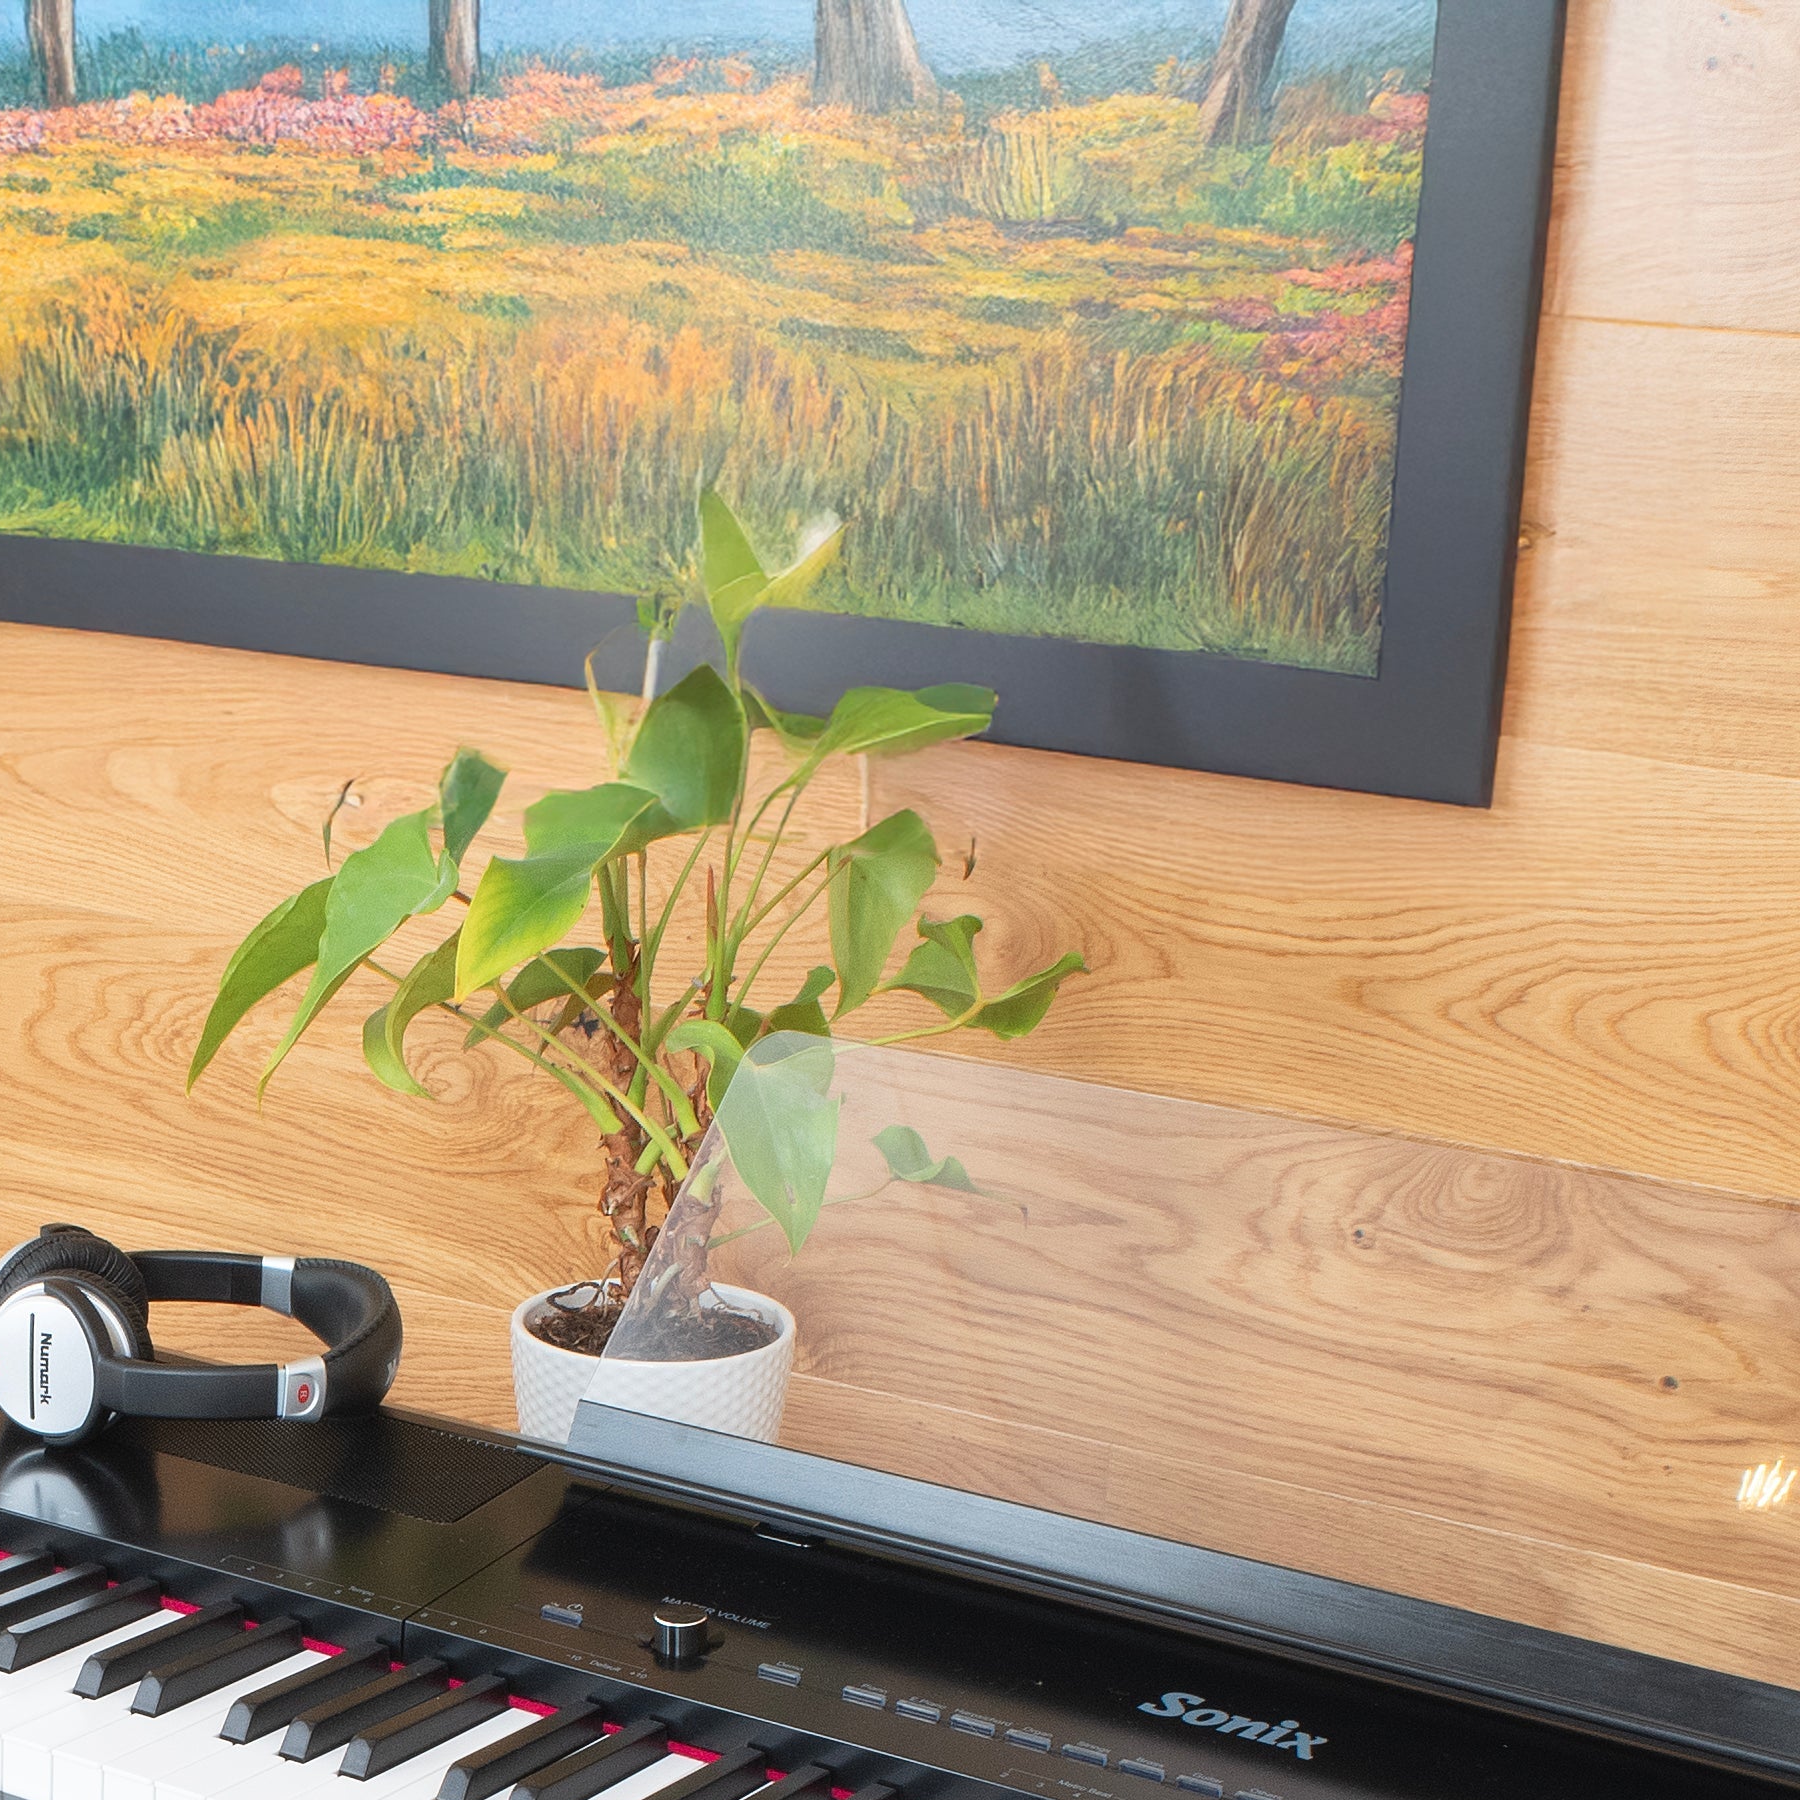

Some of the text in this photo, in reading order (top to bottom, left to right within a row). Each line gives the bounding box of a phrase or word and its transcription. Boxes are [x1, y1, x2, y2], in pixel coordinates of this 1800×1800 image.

[40, 1332, 52, 1405] Numark
[661, 1596, 772, 1630] MAR VOLUME
[1137, 1691, 1328, 1761] Sonix
